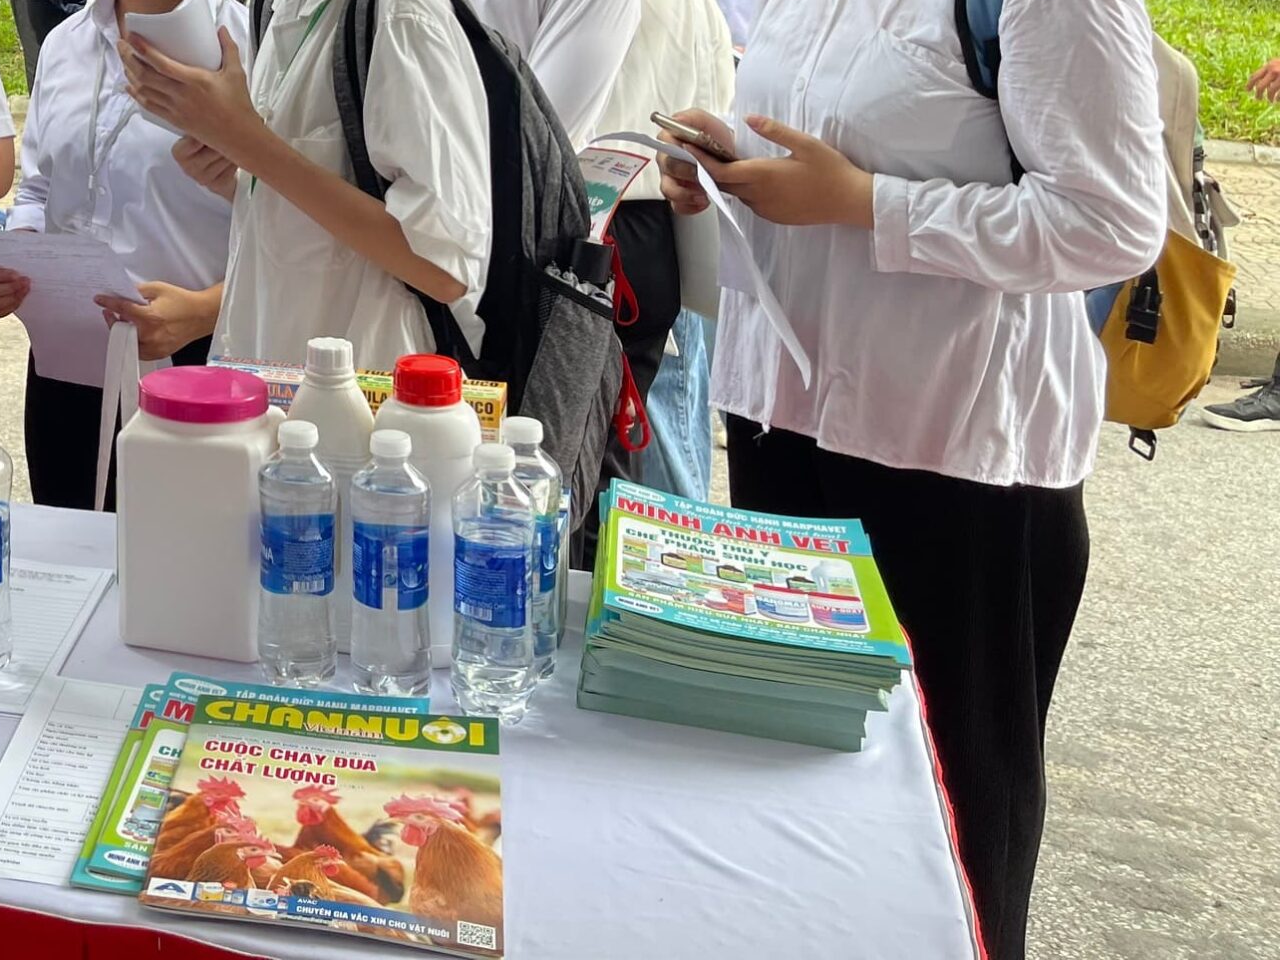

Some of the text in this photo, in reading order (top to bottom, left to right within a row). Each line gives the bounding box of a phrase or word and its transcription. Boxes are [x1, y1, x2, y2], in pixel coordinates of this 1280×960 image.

[617, 496, 851, 554] MINH ANH VET
[782, 521, 847, 533] MARPHAVET
[303, 721, 384, 740] Vietnam
[205, 738, 263, 757] CUỘC
[270, 748, 326, 768] CHẠY
[334, 757, 377, 772] ĐUA
[200, 757, 336, 786] CHẤT LƯỢNG
[126, 857, 140, 866] ANH
[296, 905, 332, 918] CHUYÊN
[333, 911, 349, 921] GIA
[351, 912, 369, 923] VẮC
[370, 916, 387, 927] XIN
[388, 919, 407, 930] CHO
[409, 922, 426, 934] VẬT
[428, 927, 451, 939] NUÔI
